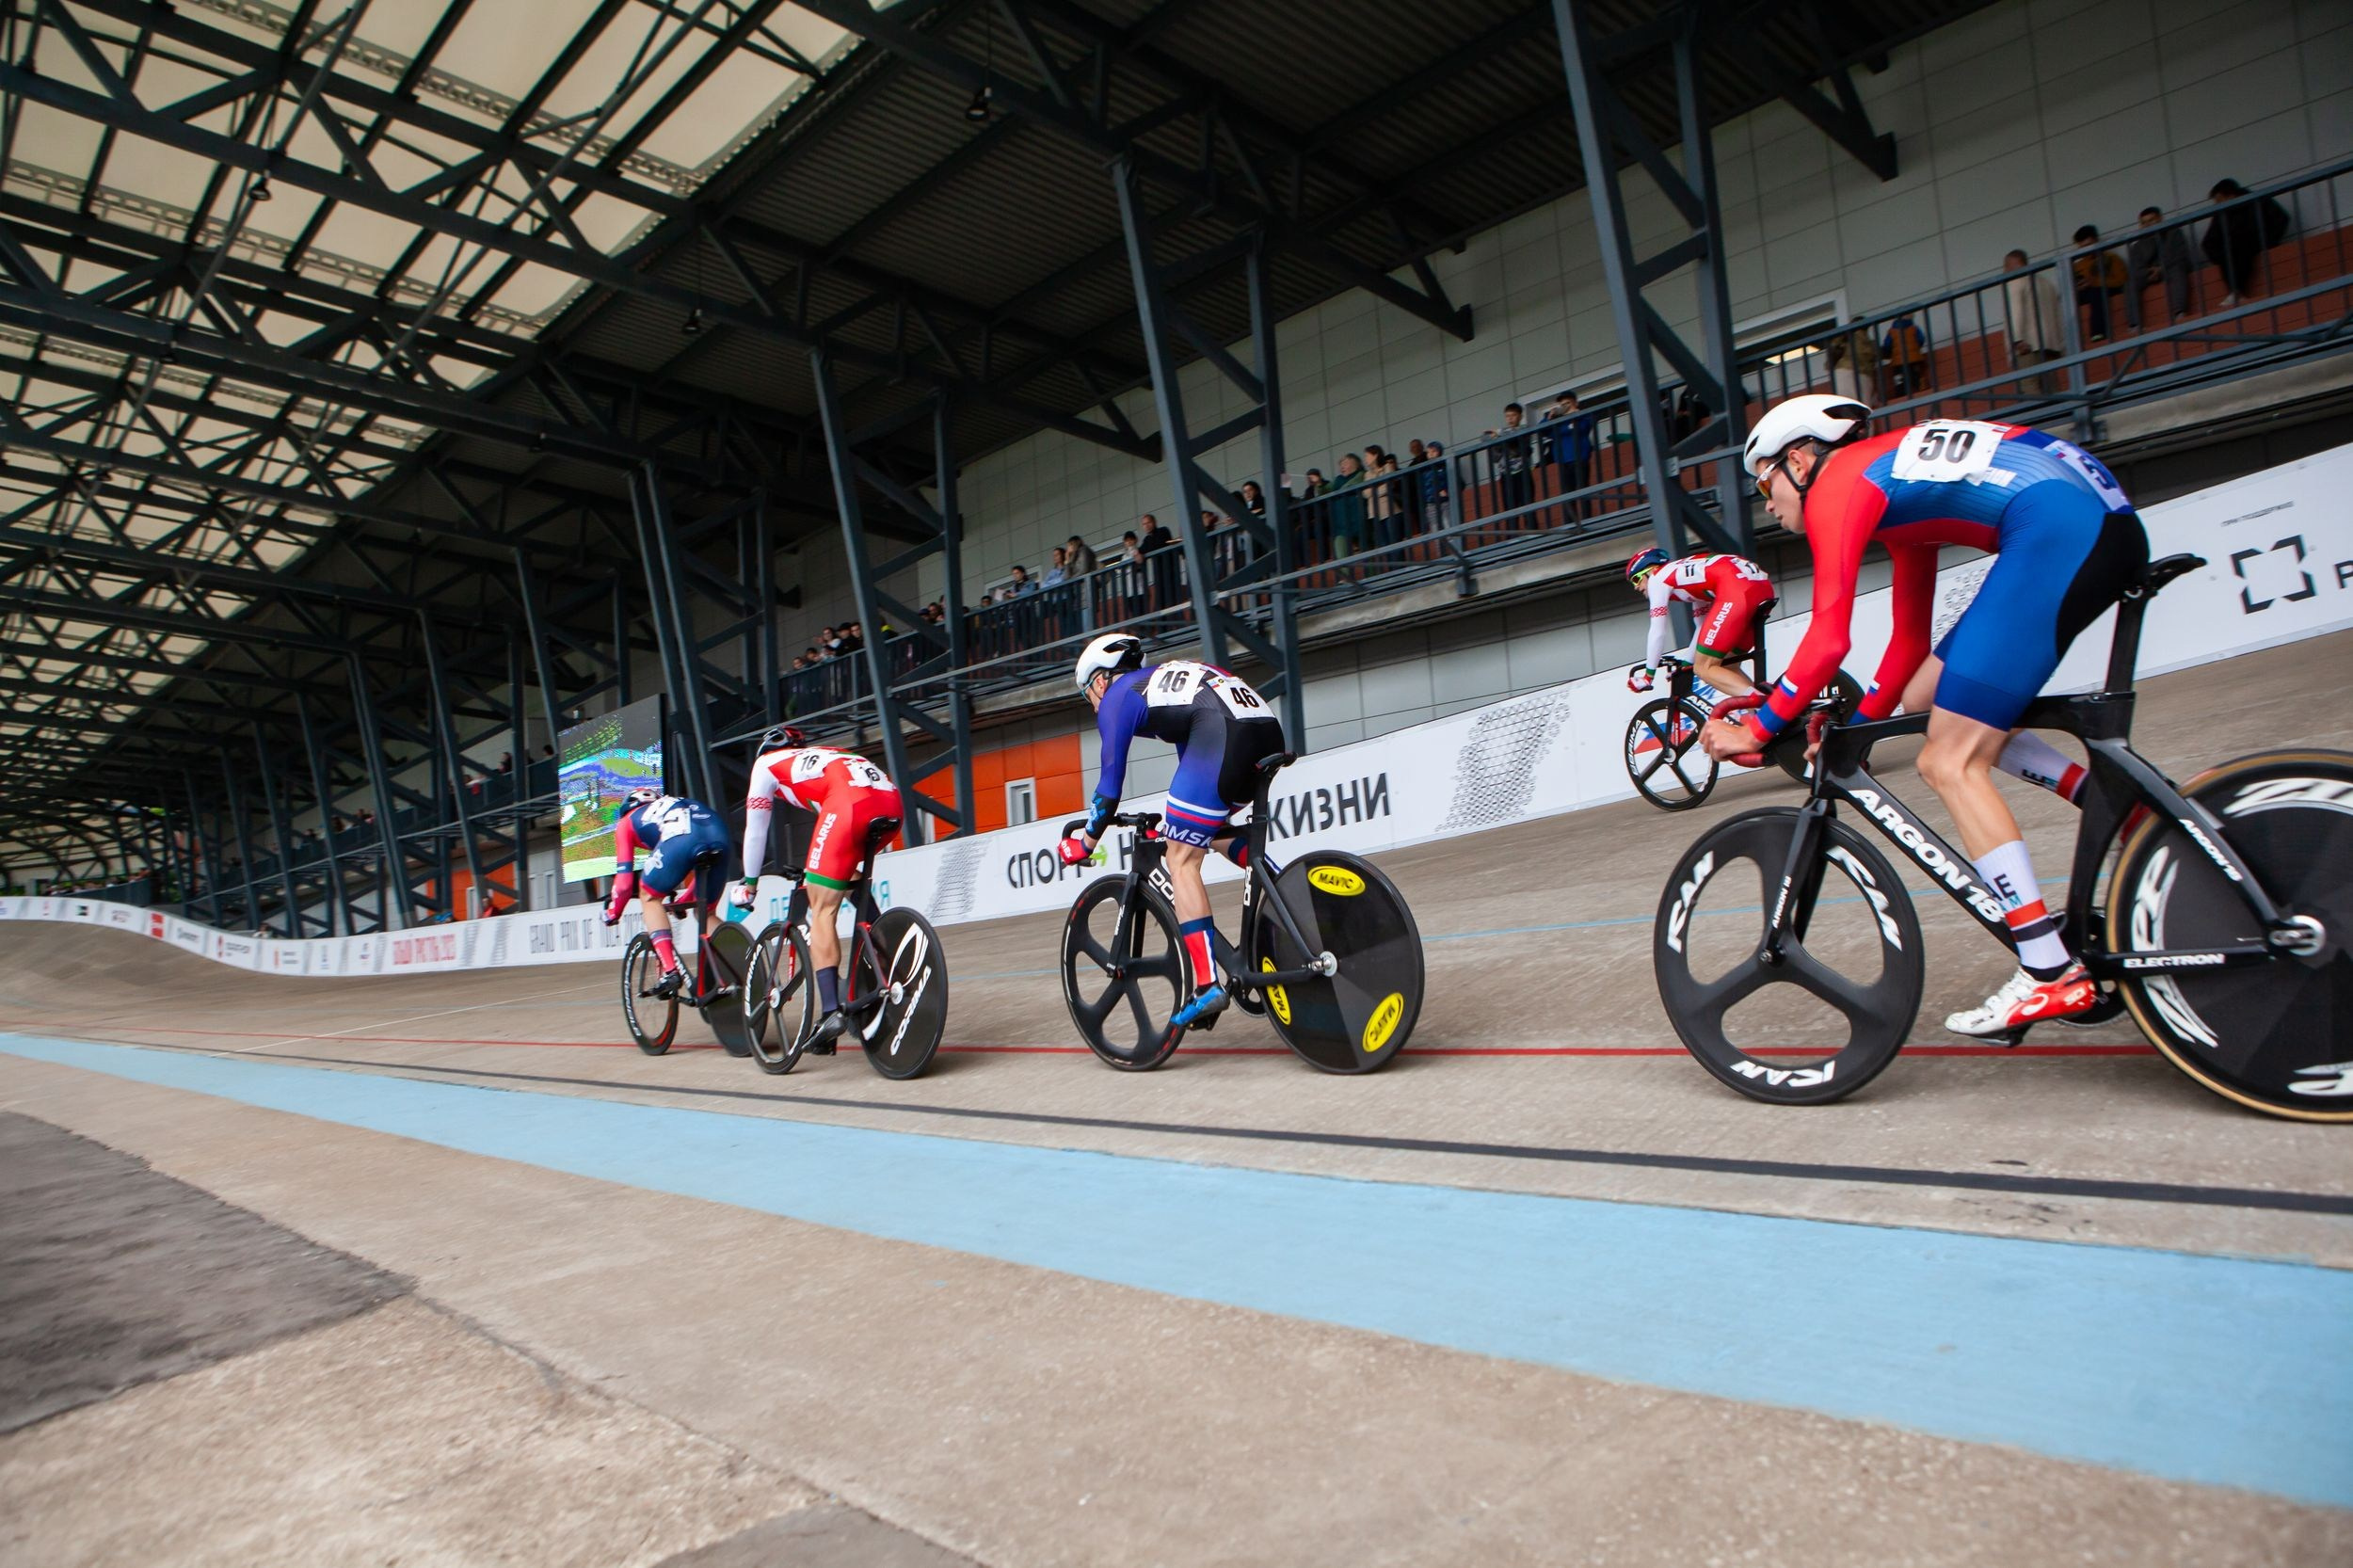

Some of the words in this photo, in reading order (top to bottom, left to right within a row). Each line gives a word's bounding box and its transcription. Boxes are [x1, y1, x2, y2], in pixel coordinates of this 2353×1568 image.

[1917, 427, 1977, 464] 50
[1704, 601, 1734, 647] BELARUS
[1158, 670, 1190, 694] 46
[1229, 687, 1260, 709] 46
[800, 754, 821, 773] 16
[808, 812, 839, 870] BELARUS
[1849, 789, 1973, 890] ARGON
[1967, 886, 2007, 924] 18
[1317, 872, 1354, 890] MAVIC
[2123, 953, 2225, 968] ELECTRON
[1371, 1005, 1396, 1042] MAVIC
